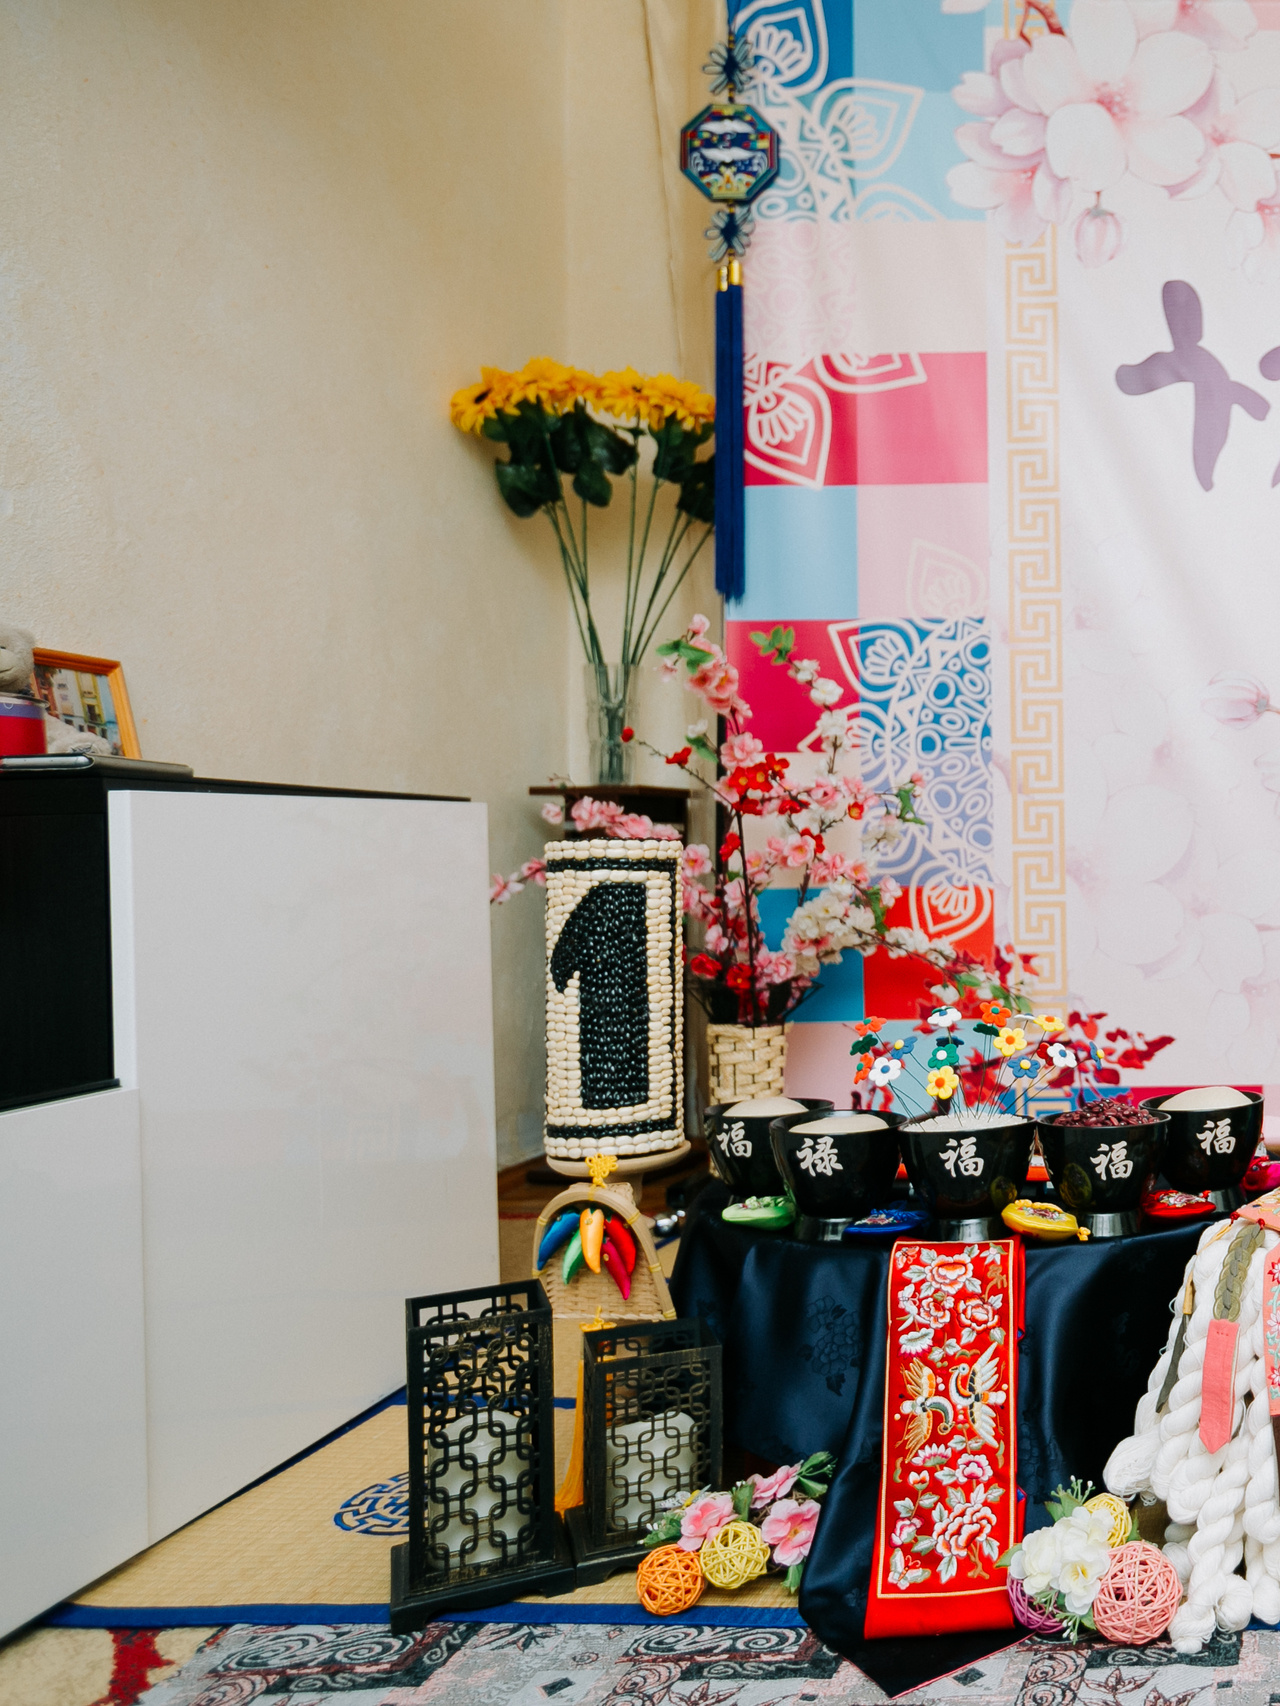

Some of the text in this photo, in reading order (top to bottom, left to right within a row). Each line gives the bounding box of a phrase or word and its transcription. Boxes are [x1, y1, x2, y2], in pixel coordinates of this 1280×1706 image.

[550, 882, 650, 1110] 1
[716, 1121, 753, 1158] 福
[938, 1136, 984, 1178] 福
[1196, 1118, 1236, 1156] 福
[1089, 1140, 1134, 1181] 福
